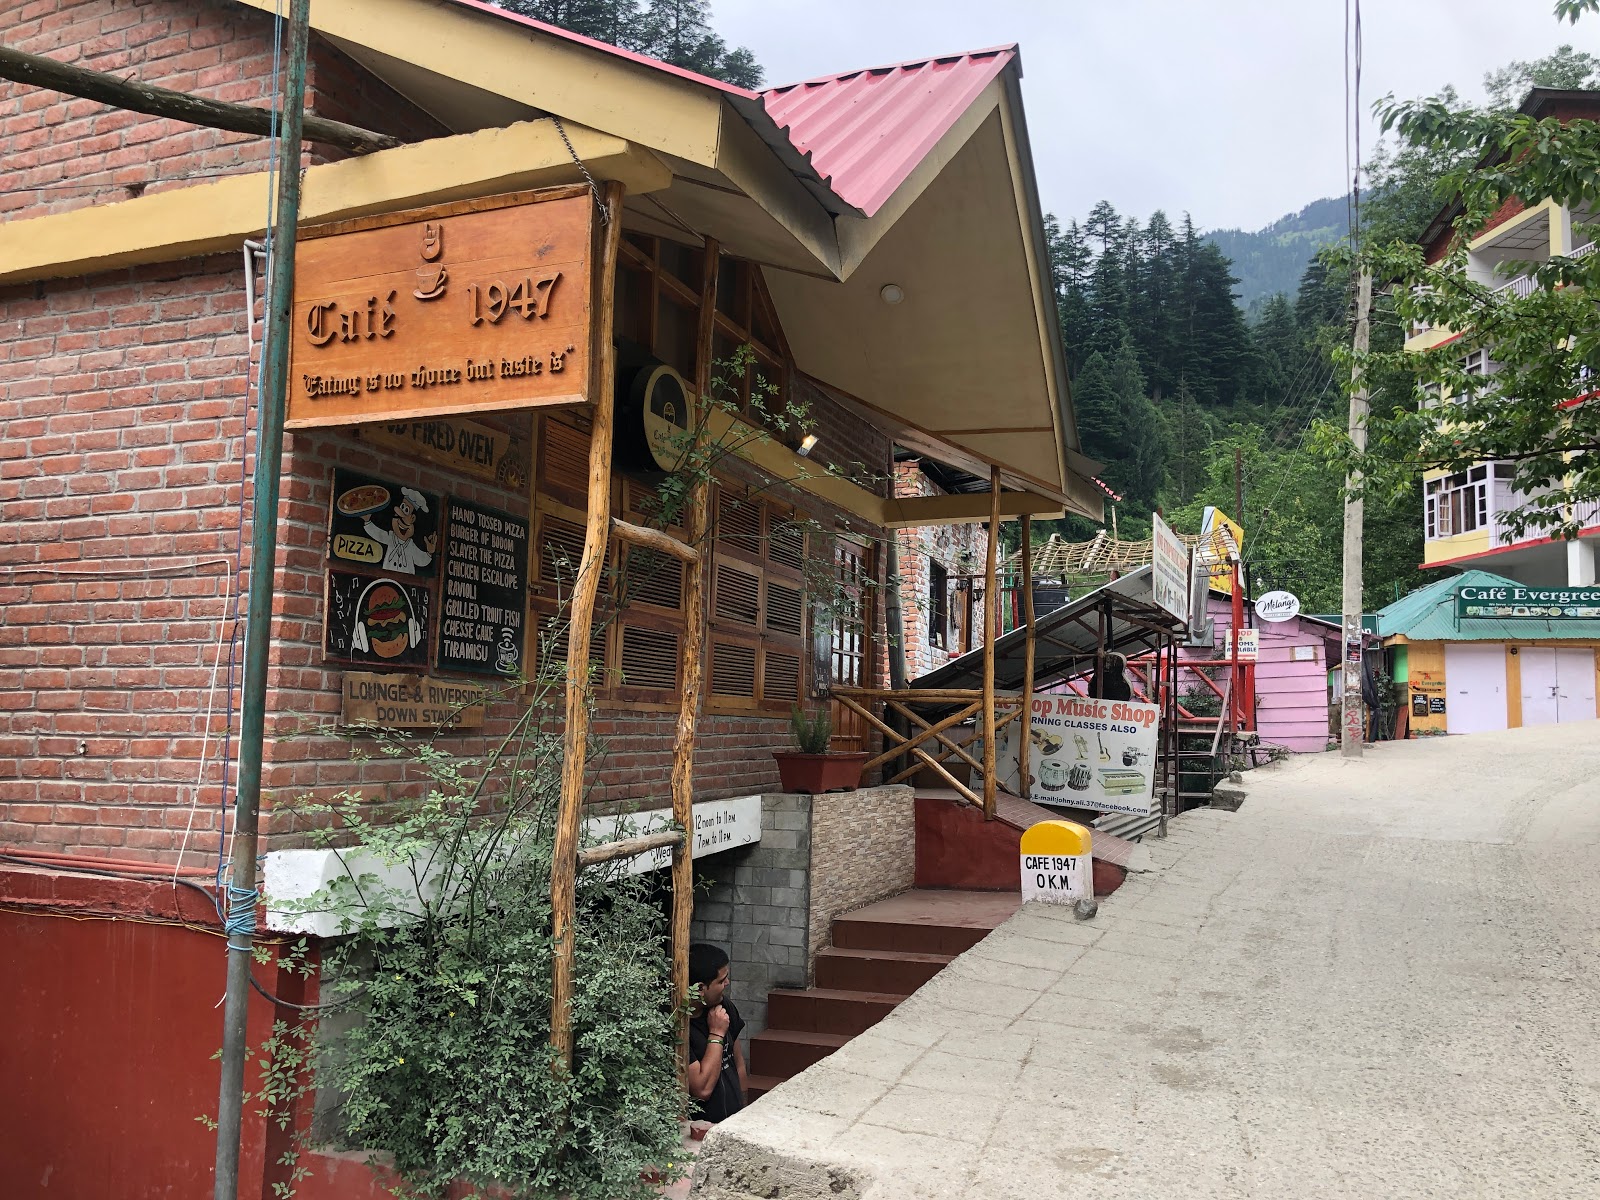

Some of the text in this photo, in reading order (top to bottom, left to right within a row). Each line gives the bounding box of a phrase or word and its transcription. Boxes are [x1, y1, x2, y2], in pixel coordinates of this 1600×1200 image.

[305, 271, 563, 347] Café 1947
[366, 373, 381, 392] is
[385, 372, 405, 390] no
[466, 359, 495, 382] but
[500, 356, 543, 379] taste
[412, 422, 494, 466] FIRED OVEN
[450, 523, 479, 543] BURGER
[481, 531, 489, 545] OF
[452, 505, 525, 540] HAND TOSSED PIZZA
[337, 536, 374, 557] PIZZA
[449, 540, 515, 570] SLAYER THE PIZZA
[448, 559, 518, 590] CHICKEN ESCALOPE
[447, 579, 477, 600] RAVIOLI
[1460, 587, 1600, 604] Café Evergree
[445, 598, 520, 628] GRILLED TROUT FISH
[443, 618, 494, 642] CHESSE CAKE
[443, 639, 488, 662] TIRAMISU
[349, 680, 407, 702] LOUNGE
[413, 685, 424, 703] &
[376, 707, 462, 724] DOWN STAIRS
[1056, 698, 1107, 719] Music
[1110, 703, 1156, 728] Shop
[1064, 720, 1108, 731] CLASSES
[1110, 724, 1137, 734] ALSO
[716, 811, 722, 825] to
[711, 831, 717, 844] to
[1025, 856, 1076, 870] CAFE 1947
